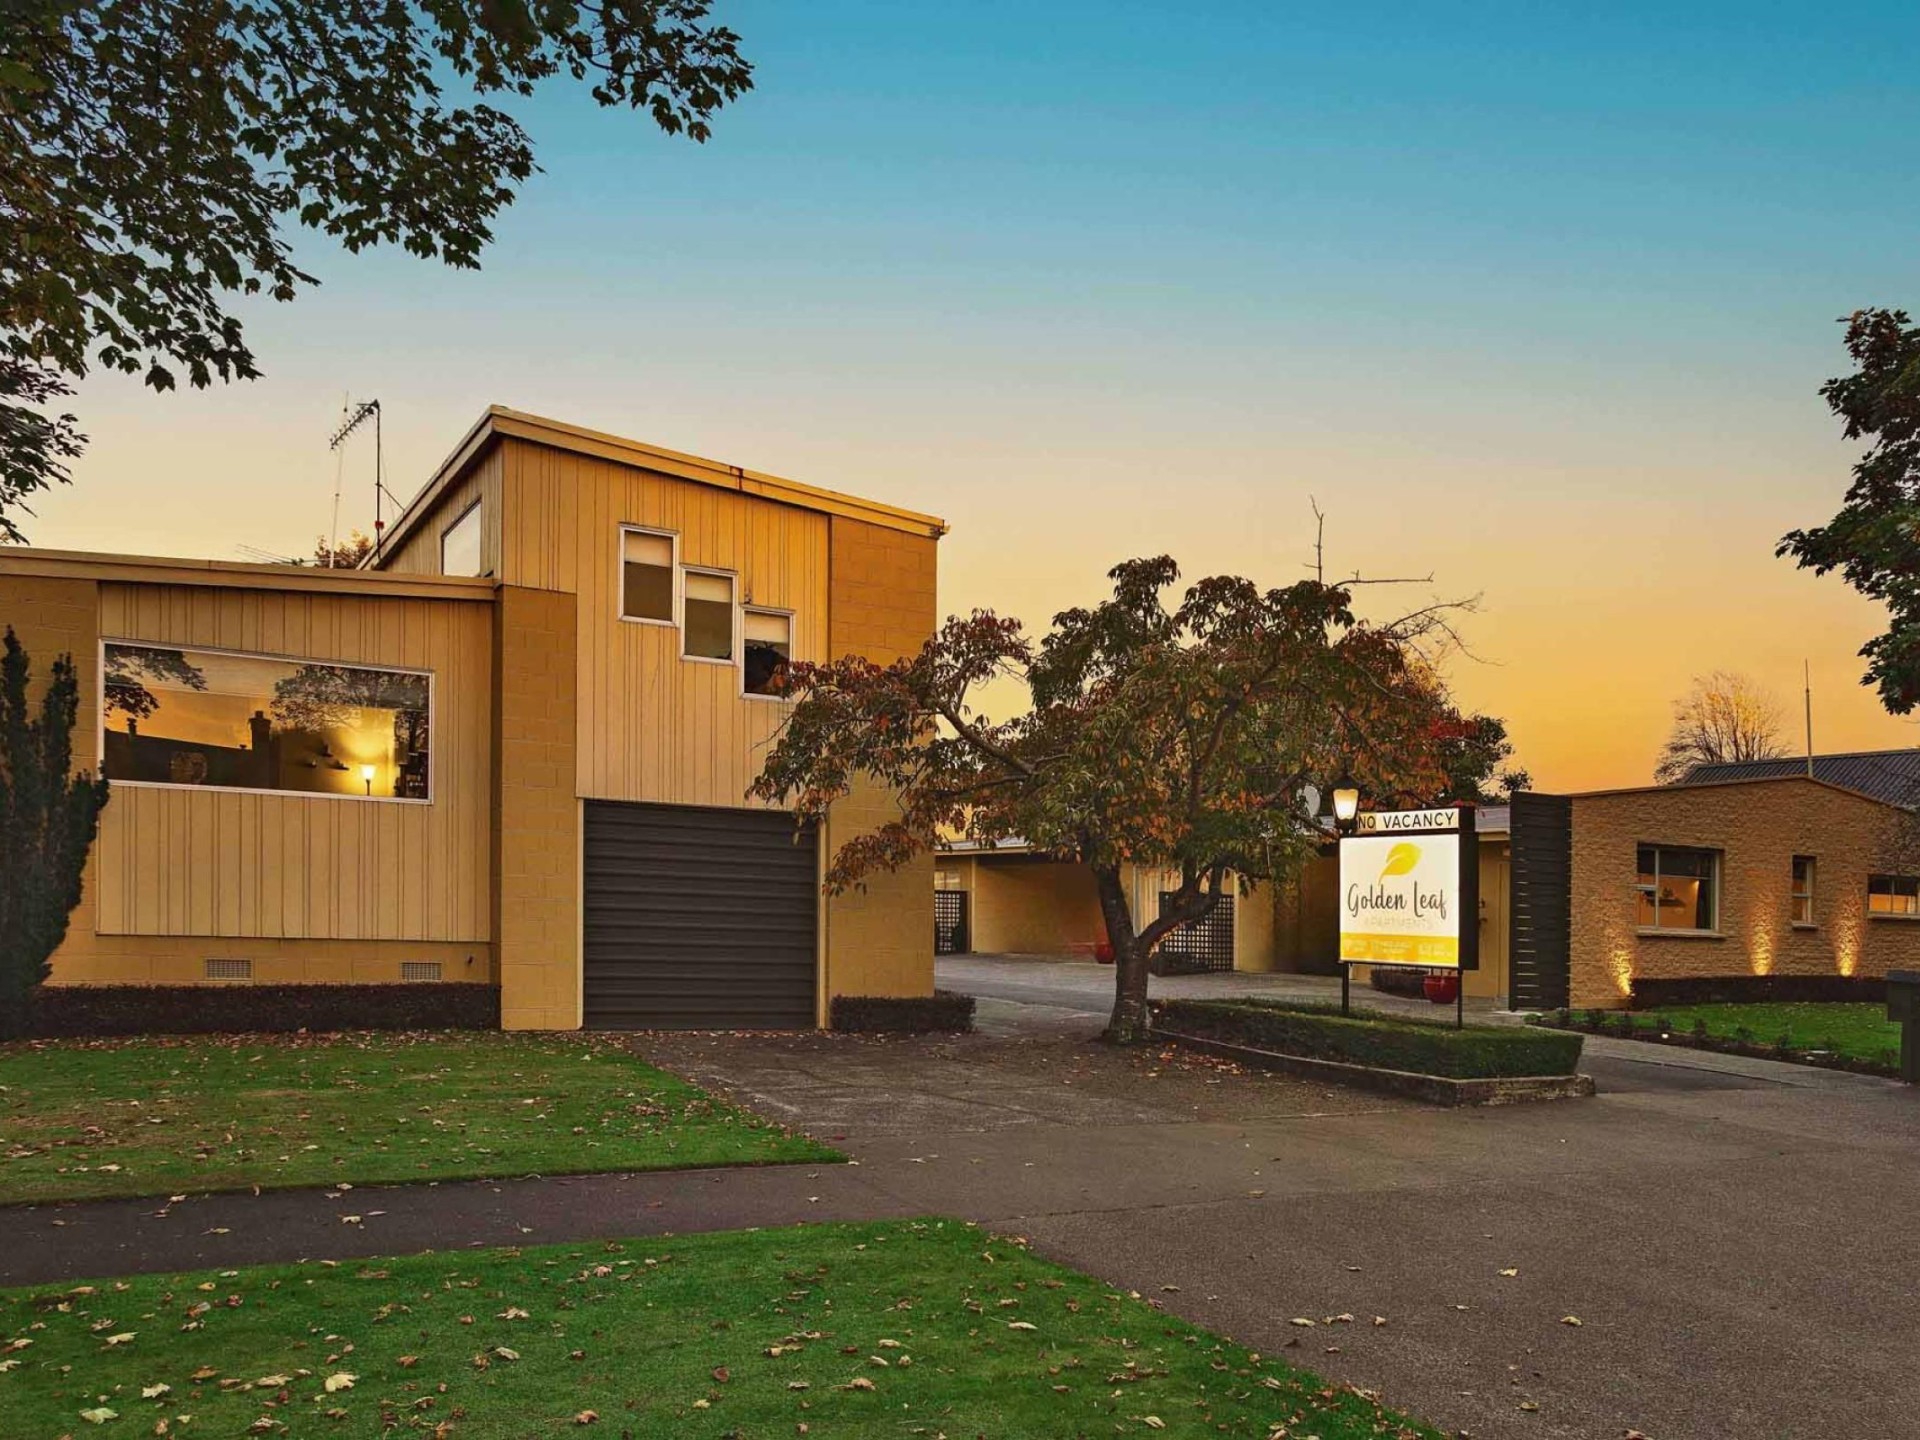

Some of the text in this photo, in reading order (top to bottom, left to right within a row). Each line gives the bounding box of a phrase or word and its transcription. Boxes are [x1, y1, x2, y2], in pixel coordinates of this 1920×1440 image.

[1358, 812, 1454, 829] NO VACANCY
[1347, 880, 1447, 920] Golden Leaf
